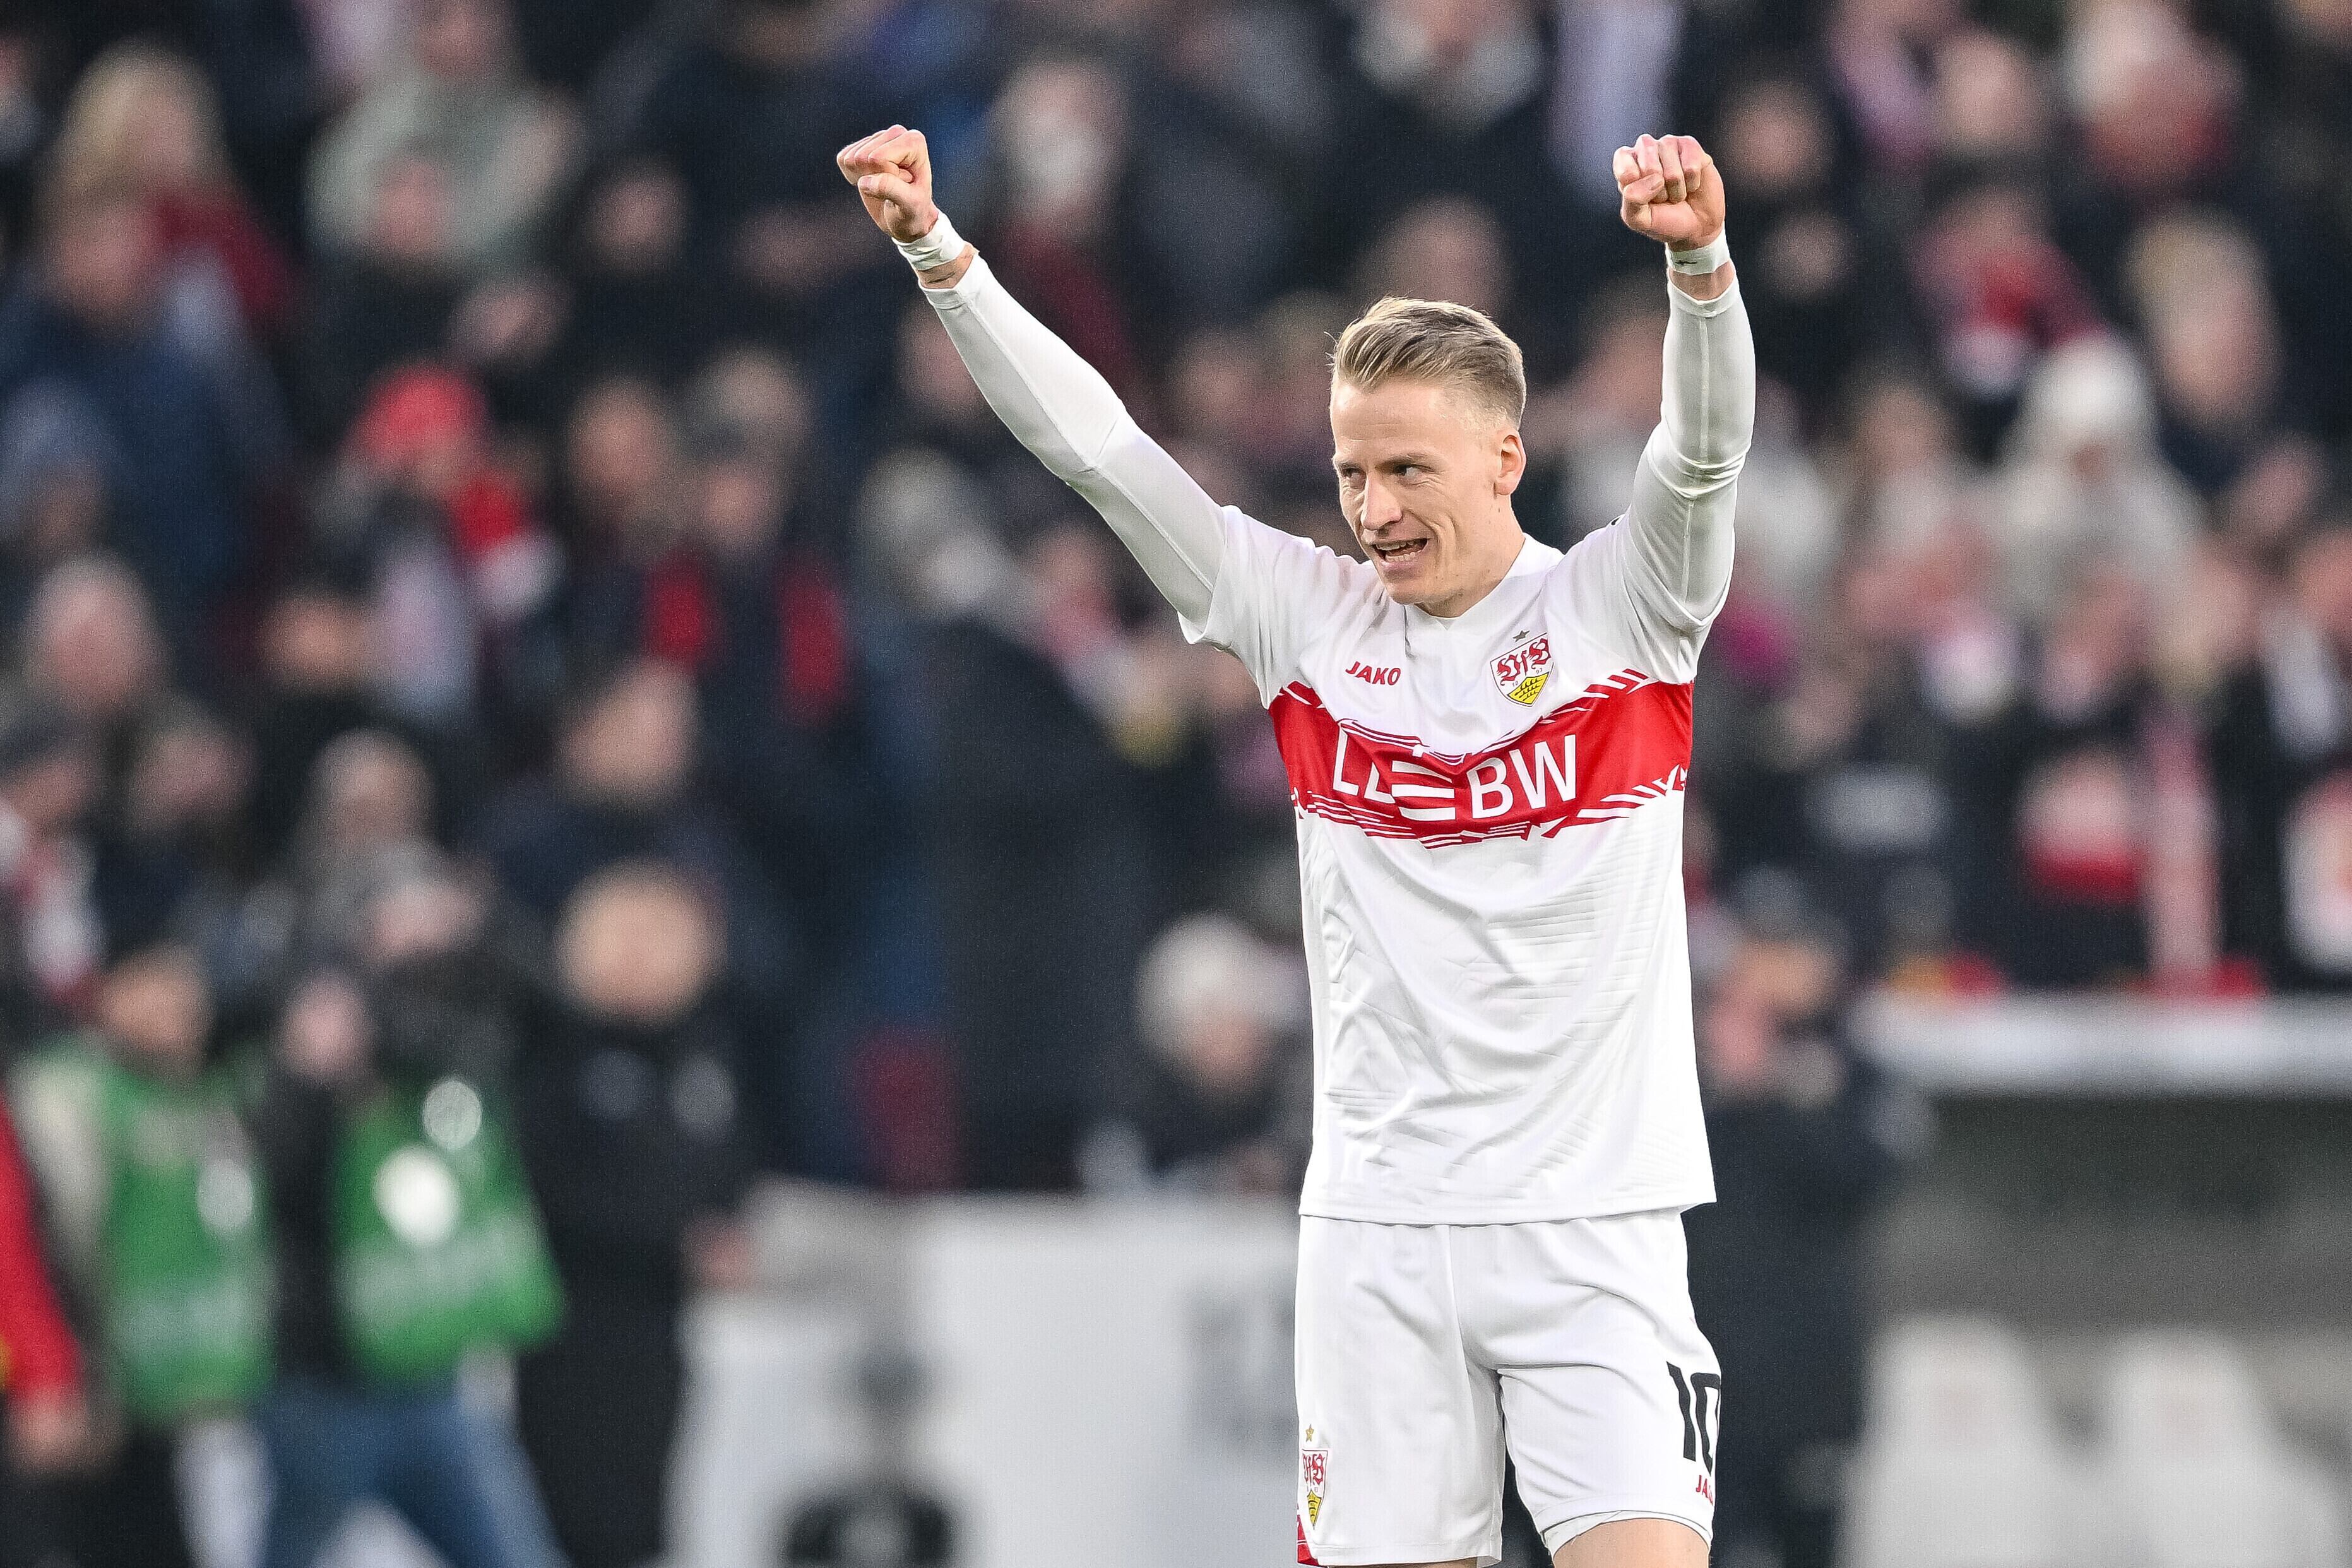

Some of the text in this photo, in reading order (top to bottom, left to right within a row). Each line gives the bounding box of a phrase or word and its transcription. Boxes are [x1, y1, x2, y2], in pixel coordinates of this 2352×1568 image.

[1345, 660, 1401, 686] JAKO
[1666, 1361, 1721, 1476] 10
[1696, 1475, 1714, 1506] JA
